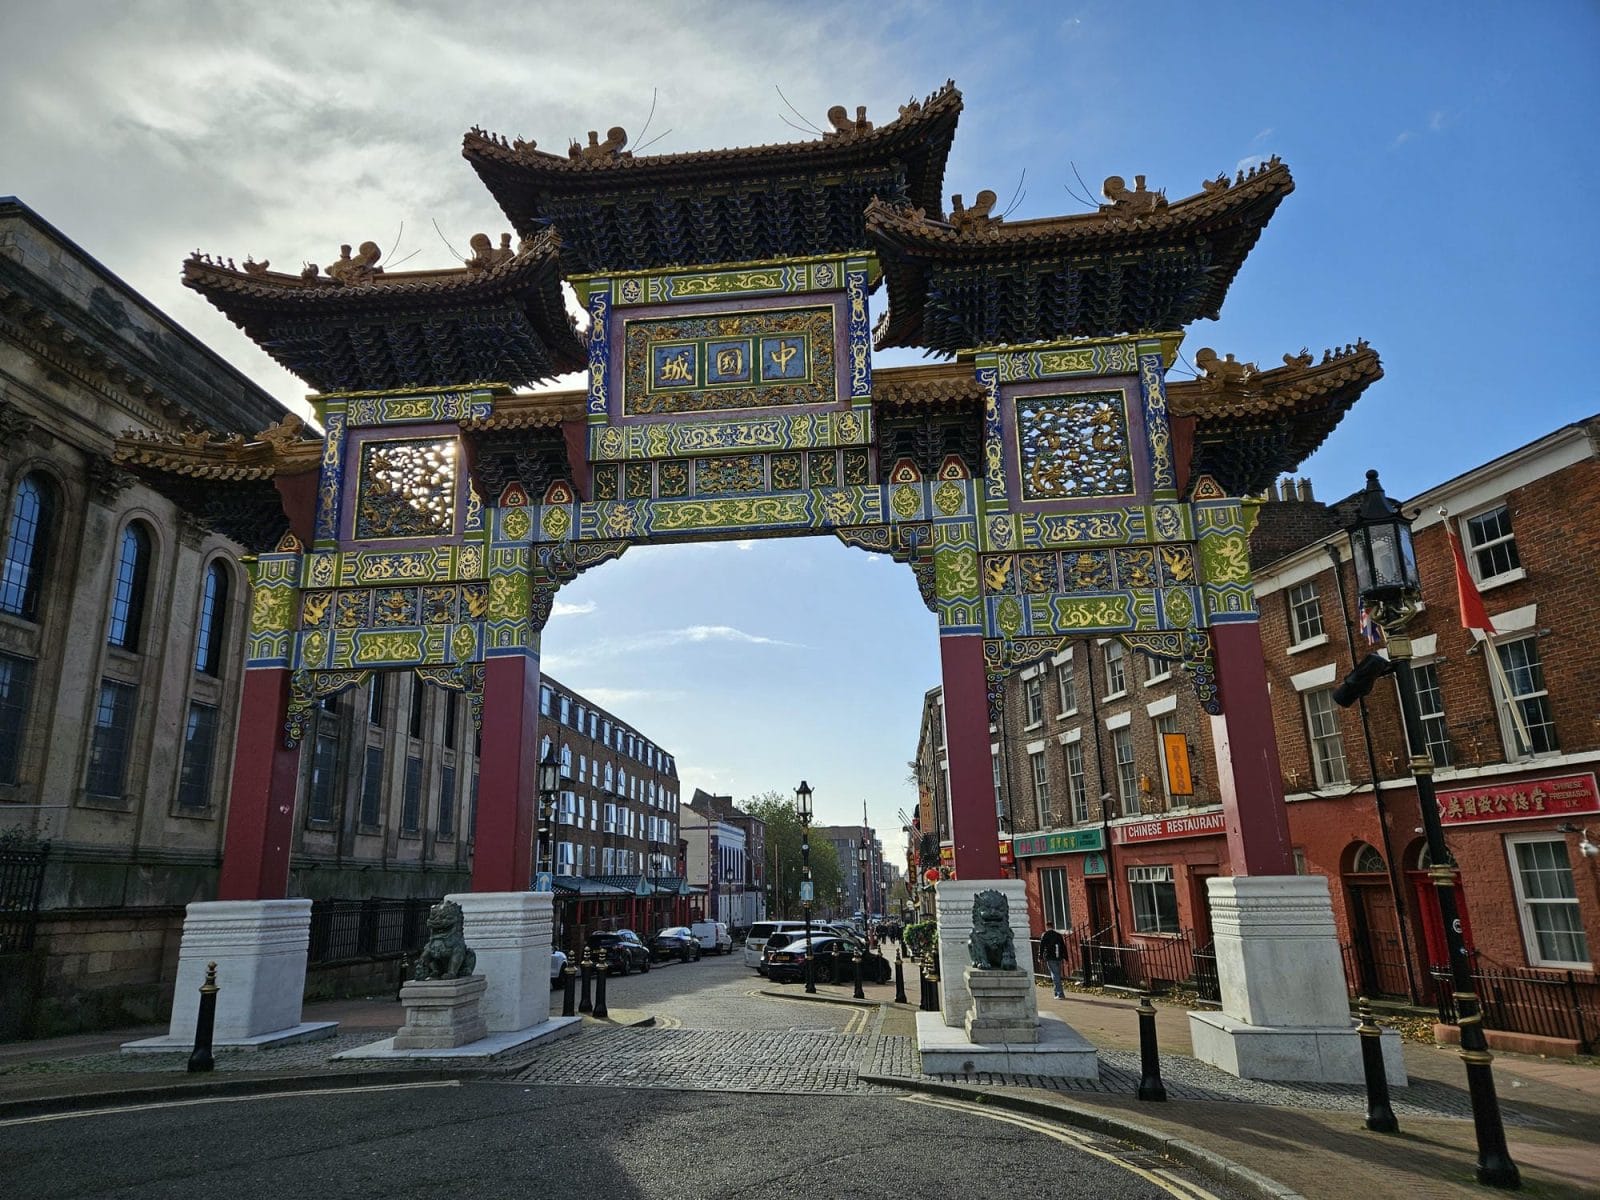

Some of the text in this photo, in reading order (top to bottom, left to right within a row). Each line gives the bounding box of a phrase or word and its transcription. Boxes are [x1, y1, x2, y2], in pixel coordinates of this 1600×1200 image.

[1552, 780, 1584, 791] CHINESE
[1128, 814, 1225, 837] CHINESE RESTAURANT
